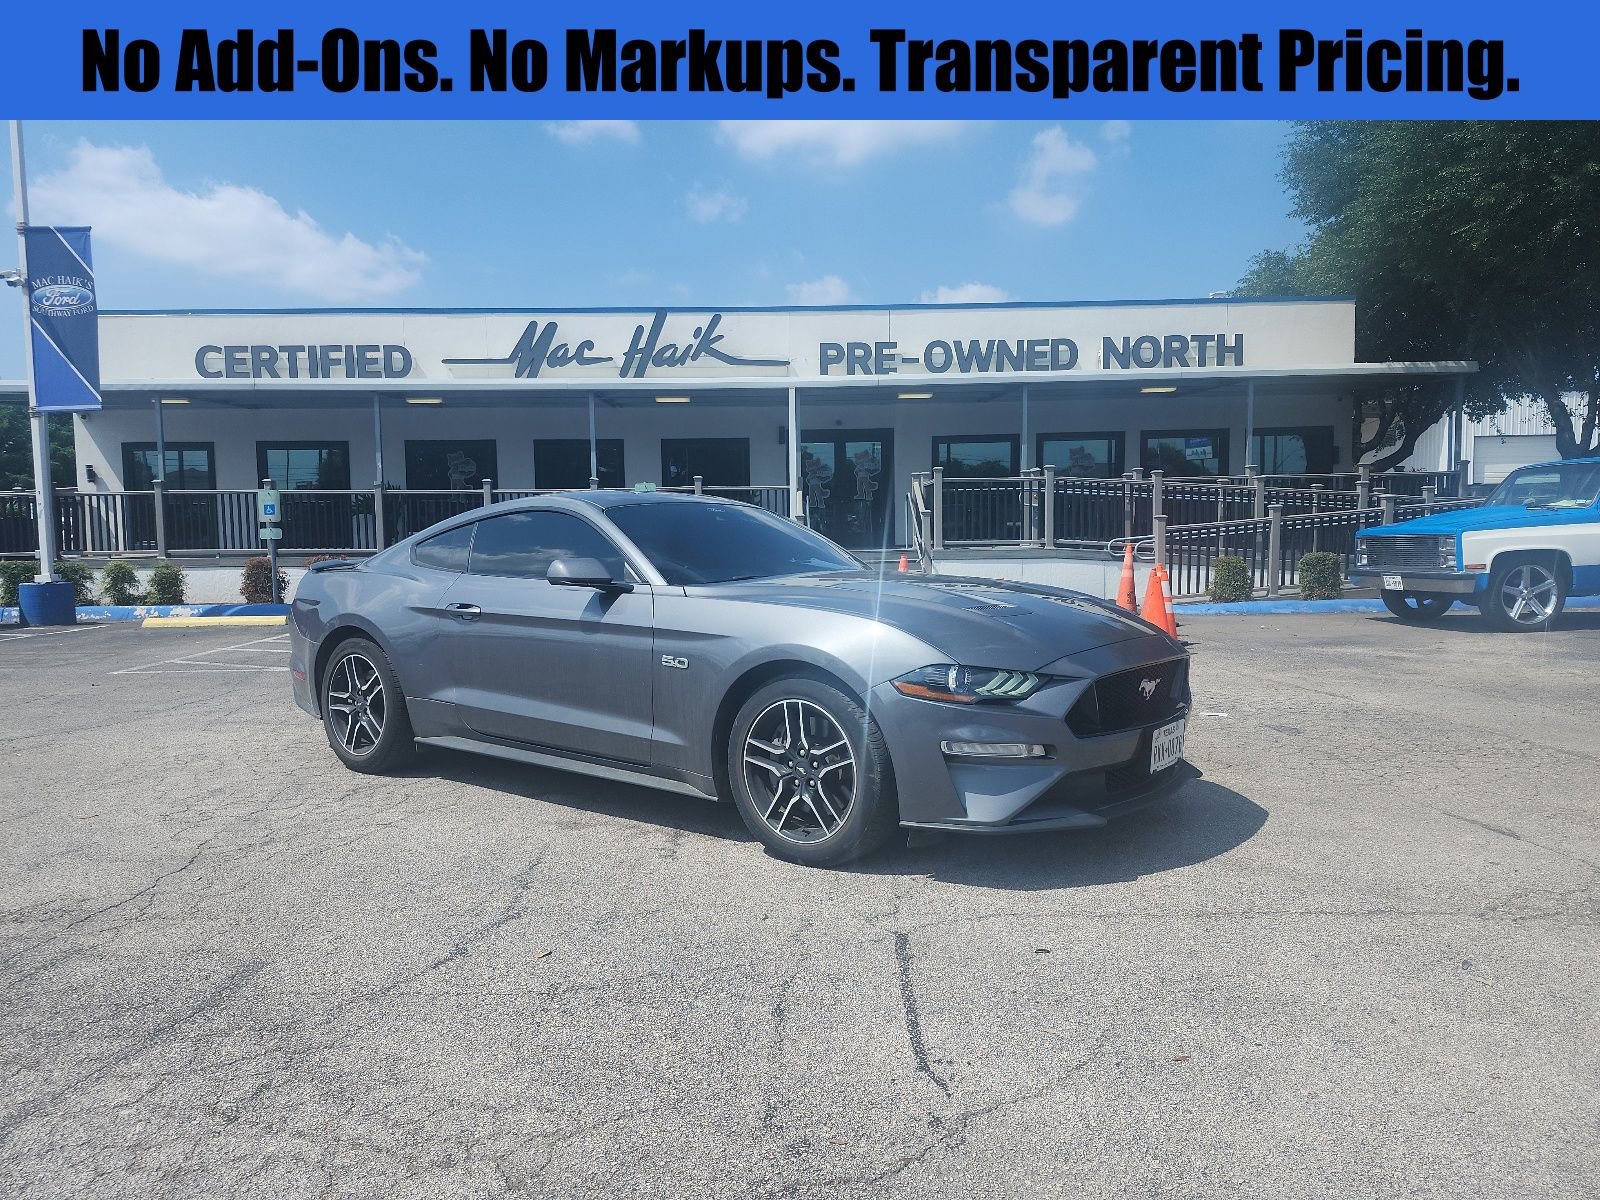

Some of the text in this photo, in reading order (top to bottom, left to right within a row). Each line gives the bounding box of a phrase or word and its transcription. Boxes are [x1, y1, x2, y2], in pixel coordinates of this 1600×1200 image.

[32, 275, 93, 289] MAC HAIK'S
[42, 289, 81, 305] Ford
[73, 305, 94, 316] FORD
[619, 309, 790, 378] Haik
[819, 333, 1244, 376] PRE-OWNED NORTH
[195, 345, 412, 379] CERTIFIED
